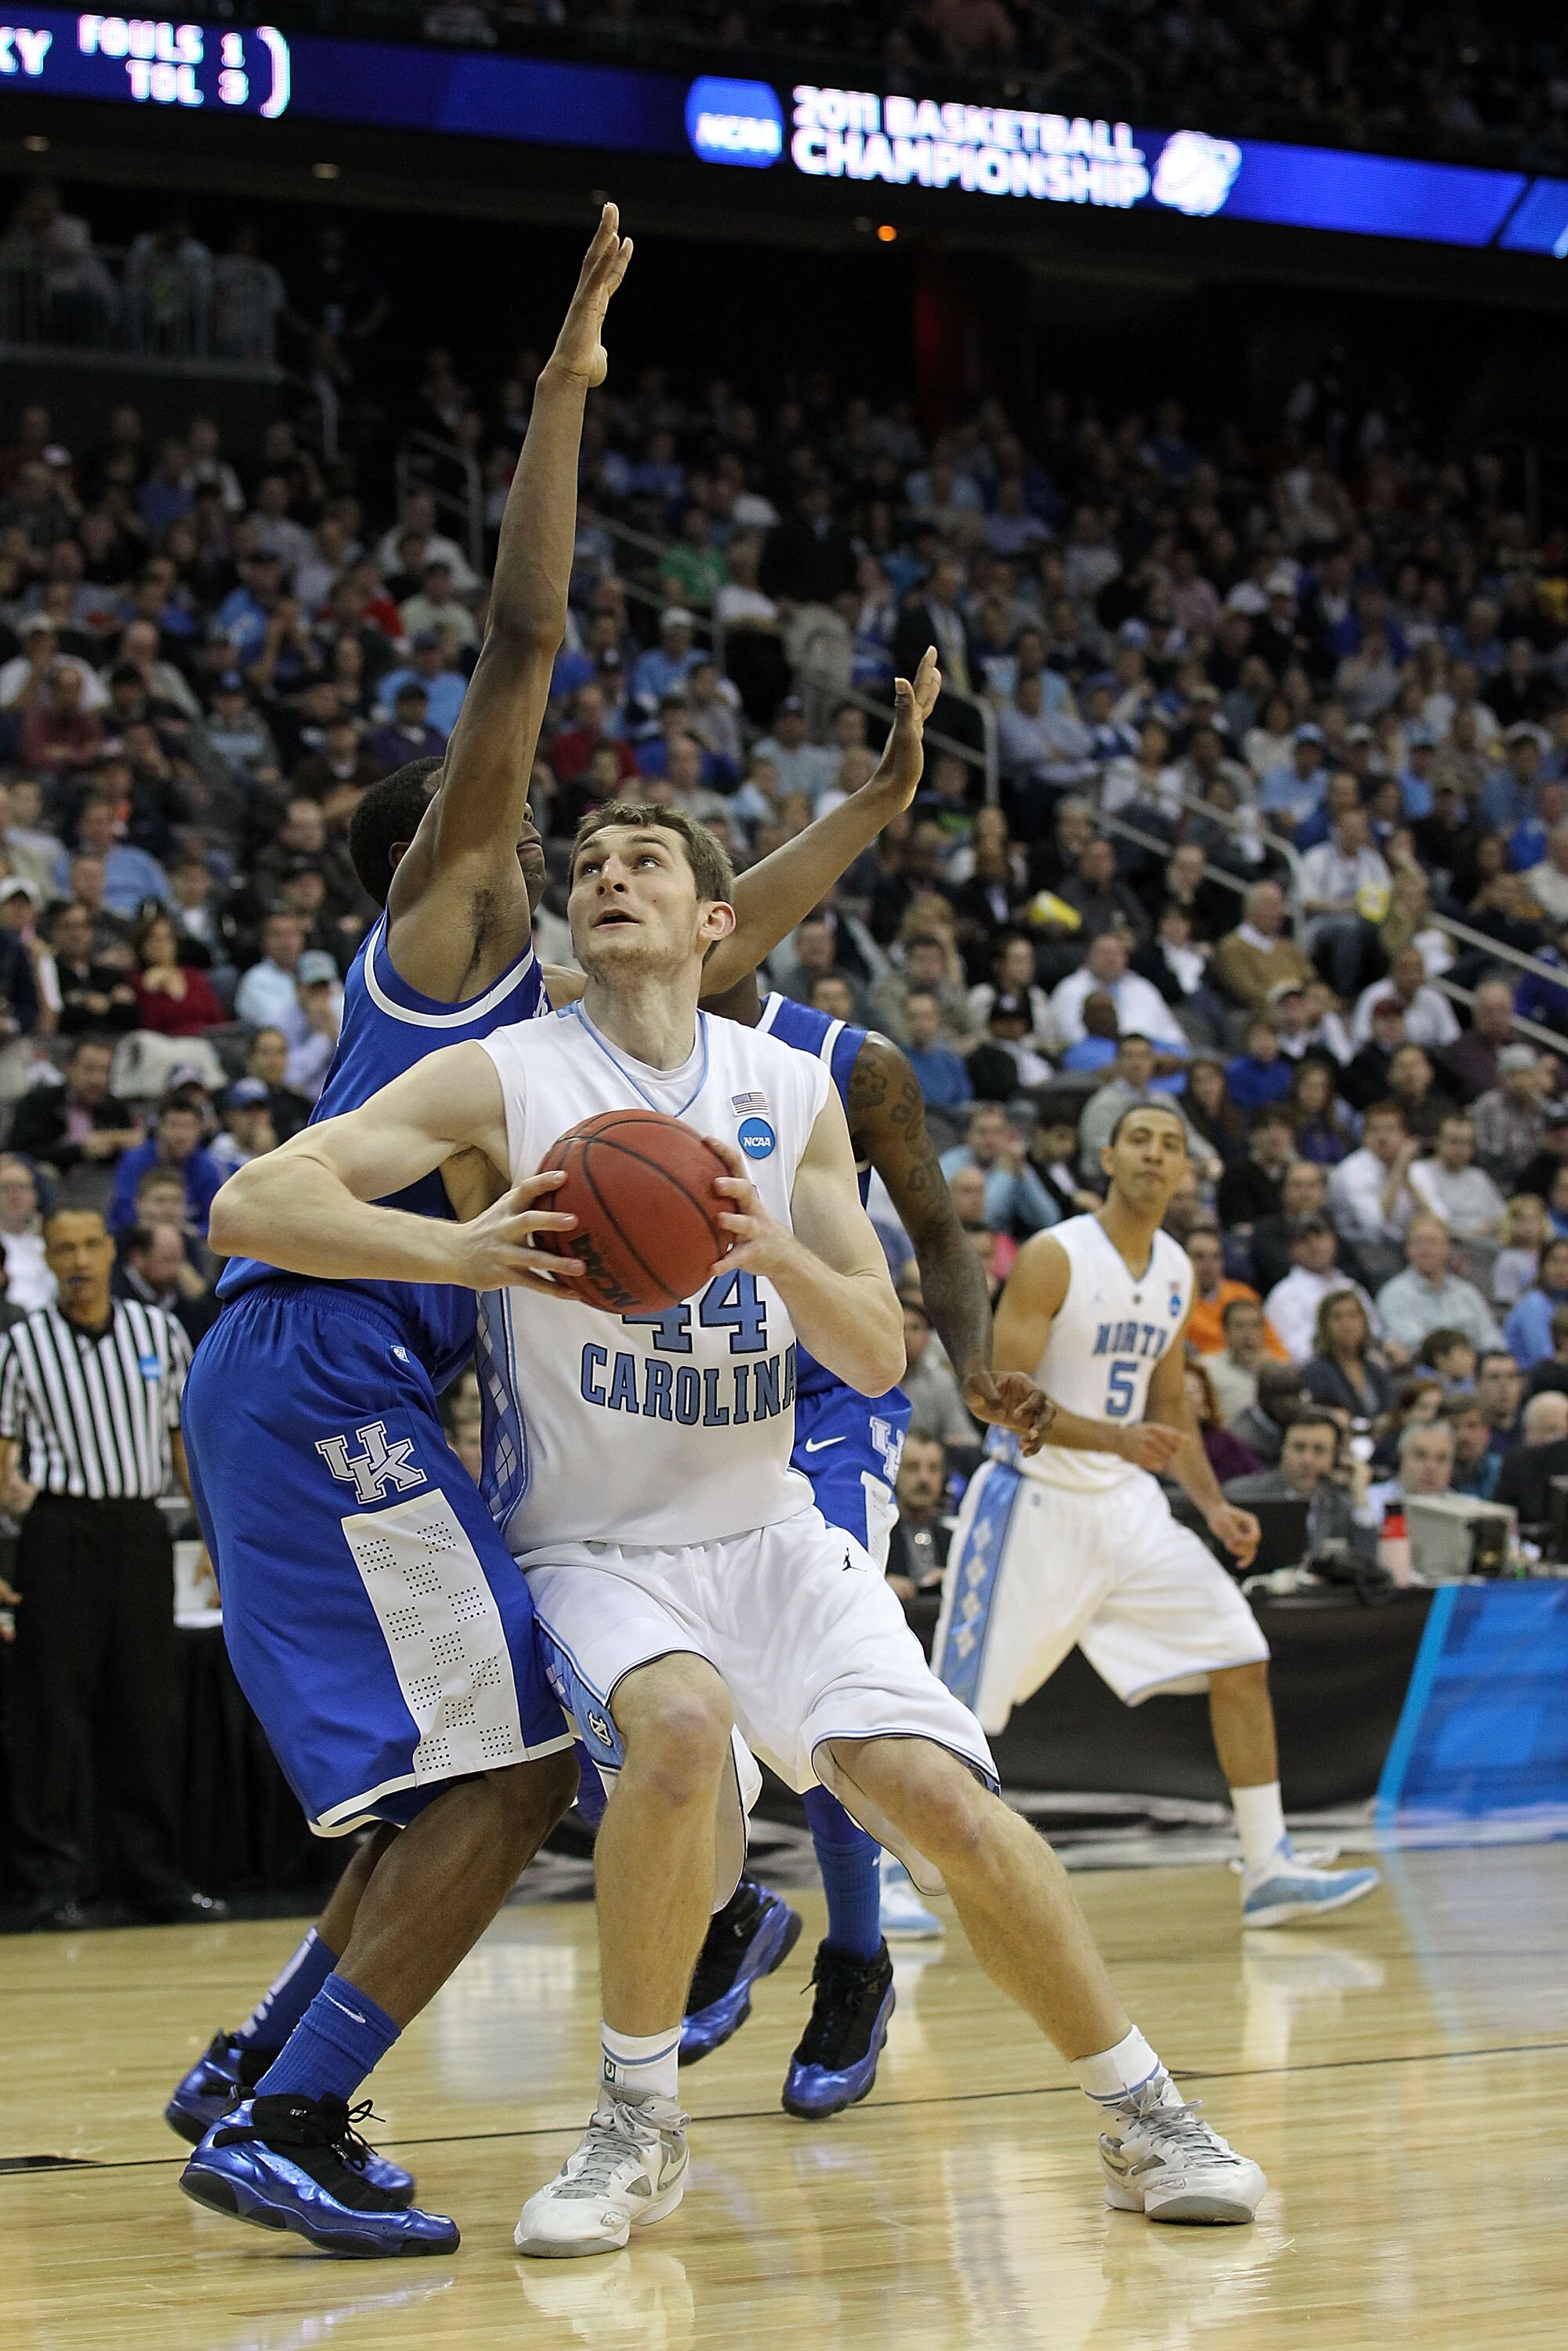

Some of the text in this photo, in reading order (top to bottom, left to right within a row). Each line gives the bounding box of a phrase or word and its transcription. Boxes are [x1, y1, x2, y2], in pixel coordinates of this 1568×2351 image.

[78, 14, 245, 68] FOULS 1
[791, 85, 1145, 164] 2011 BASKETBALL
[791, 127, 1151, 208] CHAMPIONSHIP
[743, 1136, 771, 1147] NCAA
[581, 1342, 797, 1427] CAROLINA
[1105, 1360, 1140, 1417] 5
[314, 1420, 428, 1505] UK
